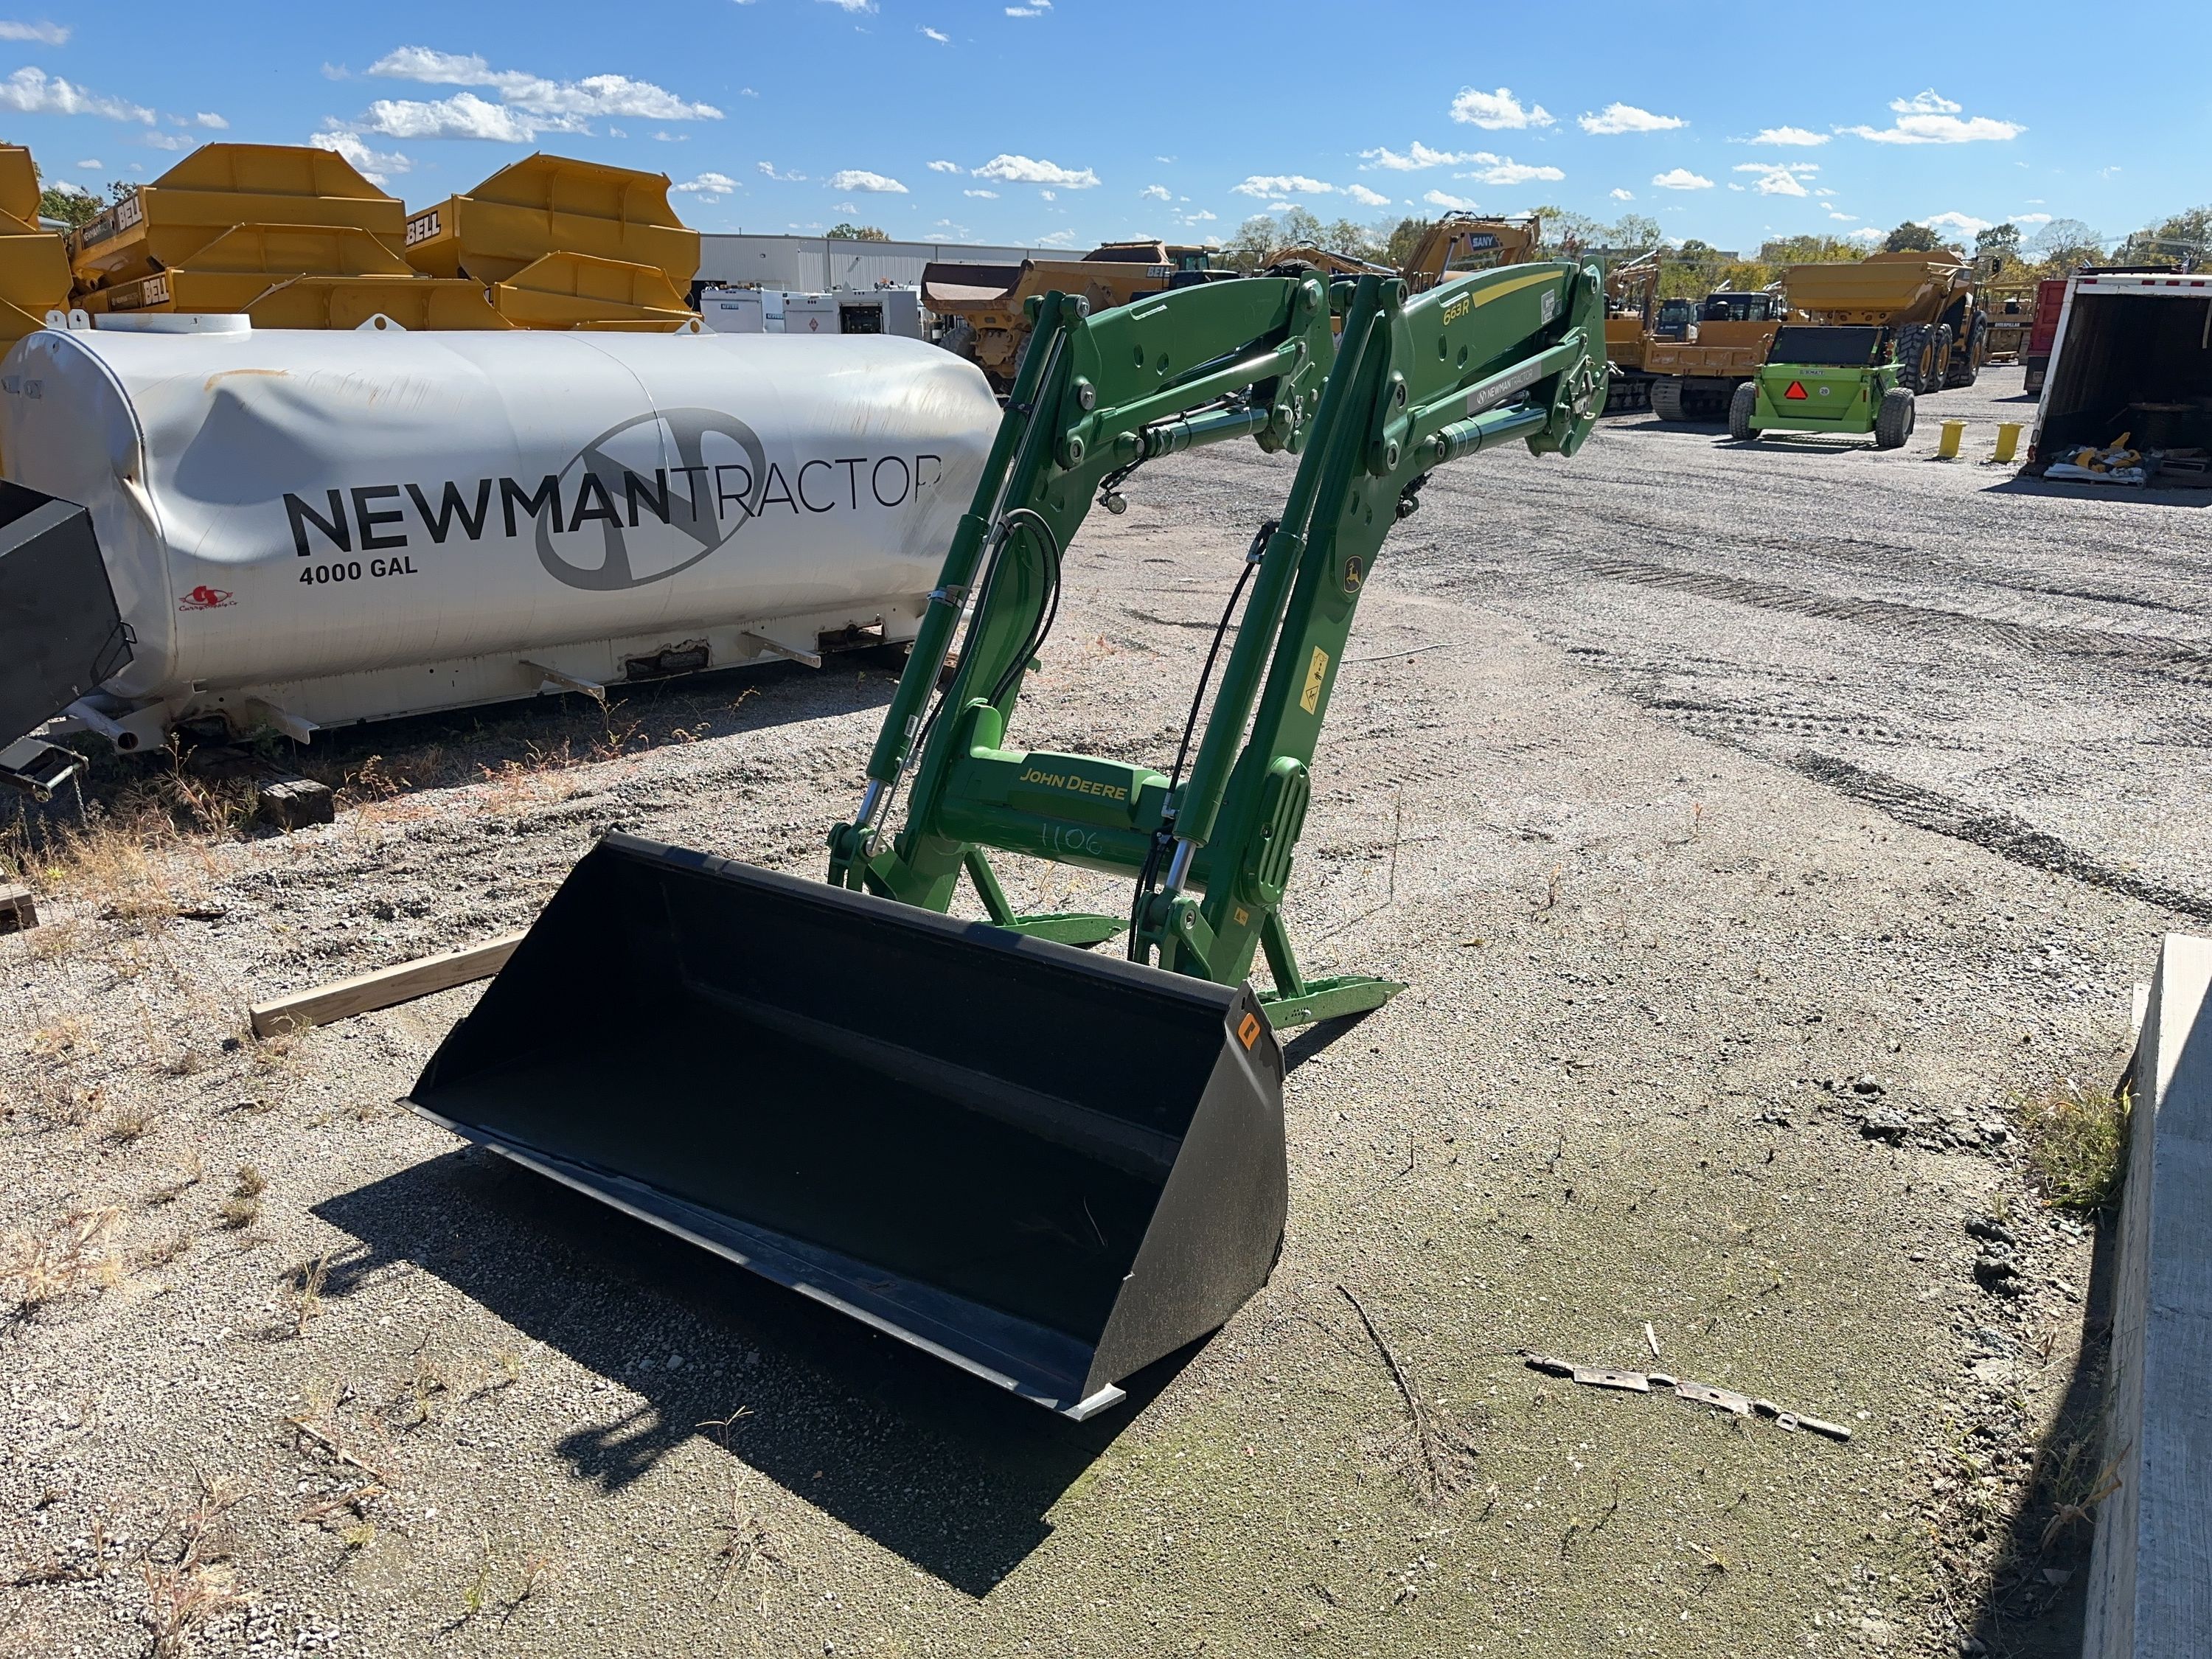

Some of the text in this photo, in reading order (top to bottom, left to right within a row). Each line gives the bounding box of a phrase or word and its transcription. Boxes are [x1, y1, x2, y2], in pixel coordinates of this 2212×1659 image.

[117, 195, 143, 231] BELL
[406, 212, 440, 246] BELL
[1472, 236, 1494, 248] SANY
[143, 276, 170, 306] BELL
[1443, 299, 1470, 326] 663R
[299, 556, 418, 586] 4000 GAL
[1020, 768, 1128, 801] JOHN DEERE
[1041, 823, 1102, 855] 1106
